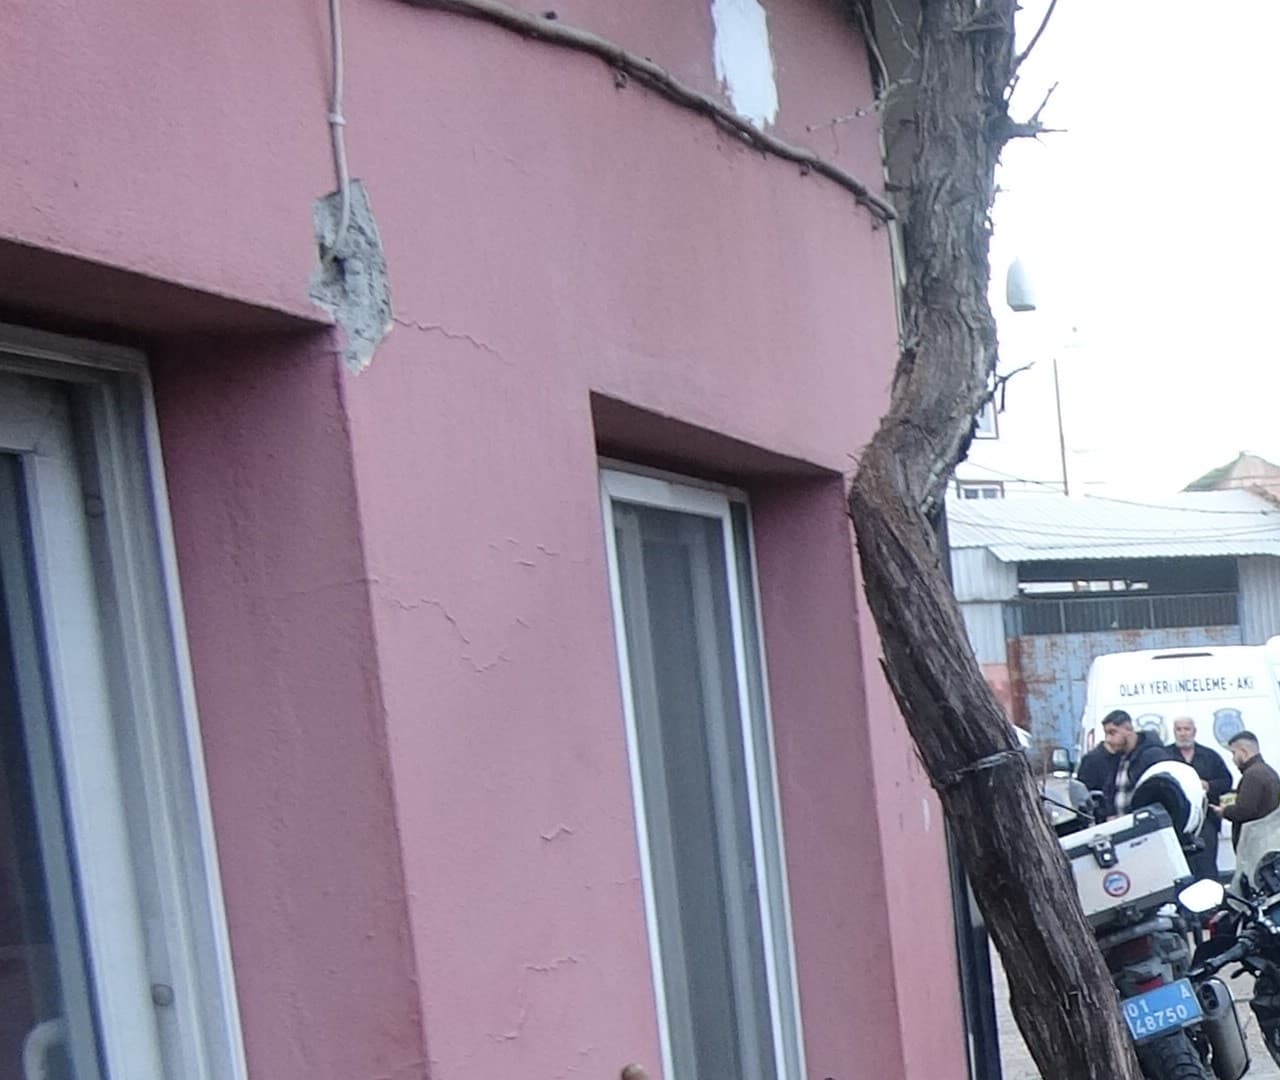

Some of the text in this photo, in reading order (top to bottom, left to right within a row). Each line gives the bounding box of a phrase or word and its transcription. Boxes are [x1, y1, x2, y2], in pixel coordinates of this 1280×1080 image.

[1119, 682, 1146, 697] OLAY
[1127, 984, 1191, 1018] 01 A
[1136, 1004, 1188, 1034] 48750
